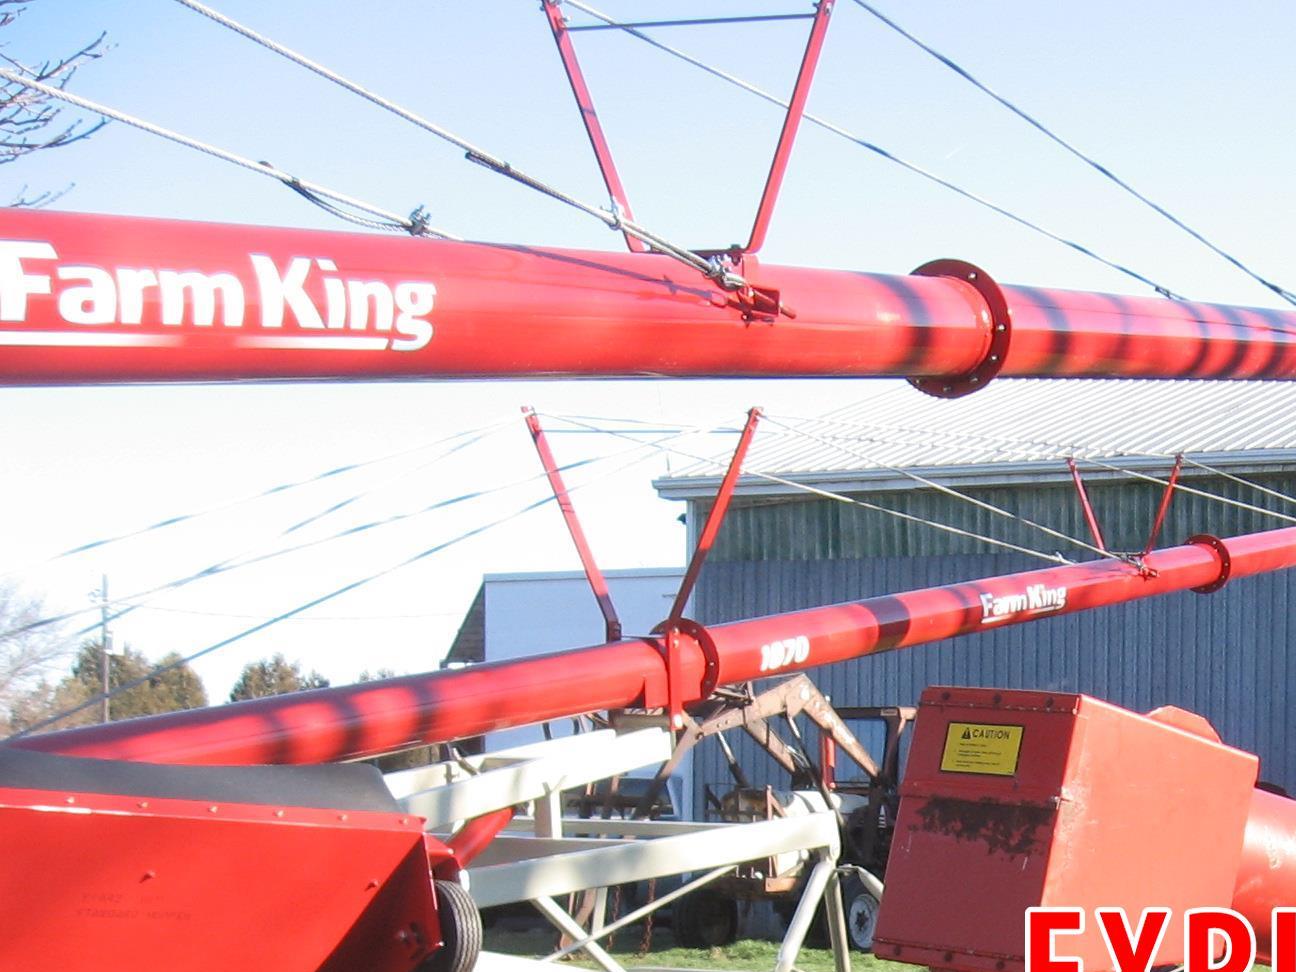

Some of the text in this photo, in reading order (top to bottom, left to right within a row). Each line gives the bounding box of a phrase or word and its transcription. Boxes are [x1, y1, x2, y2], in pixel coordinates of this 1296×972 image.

[0, 240, 437, 351] Farm King
[980, 583, 1067, 617] Farm King
[972, 728, 1011, 740] CAUTION
